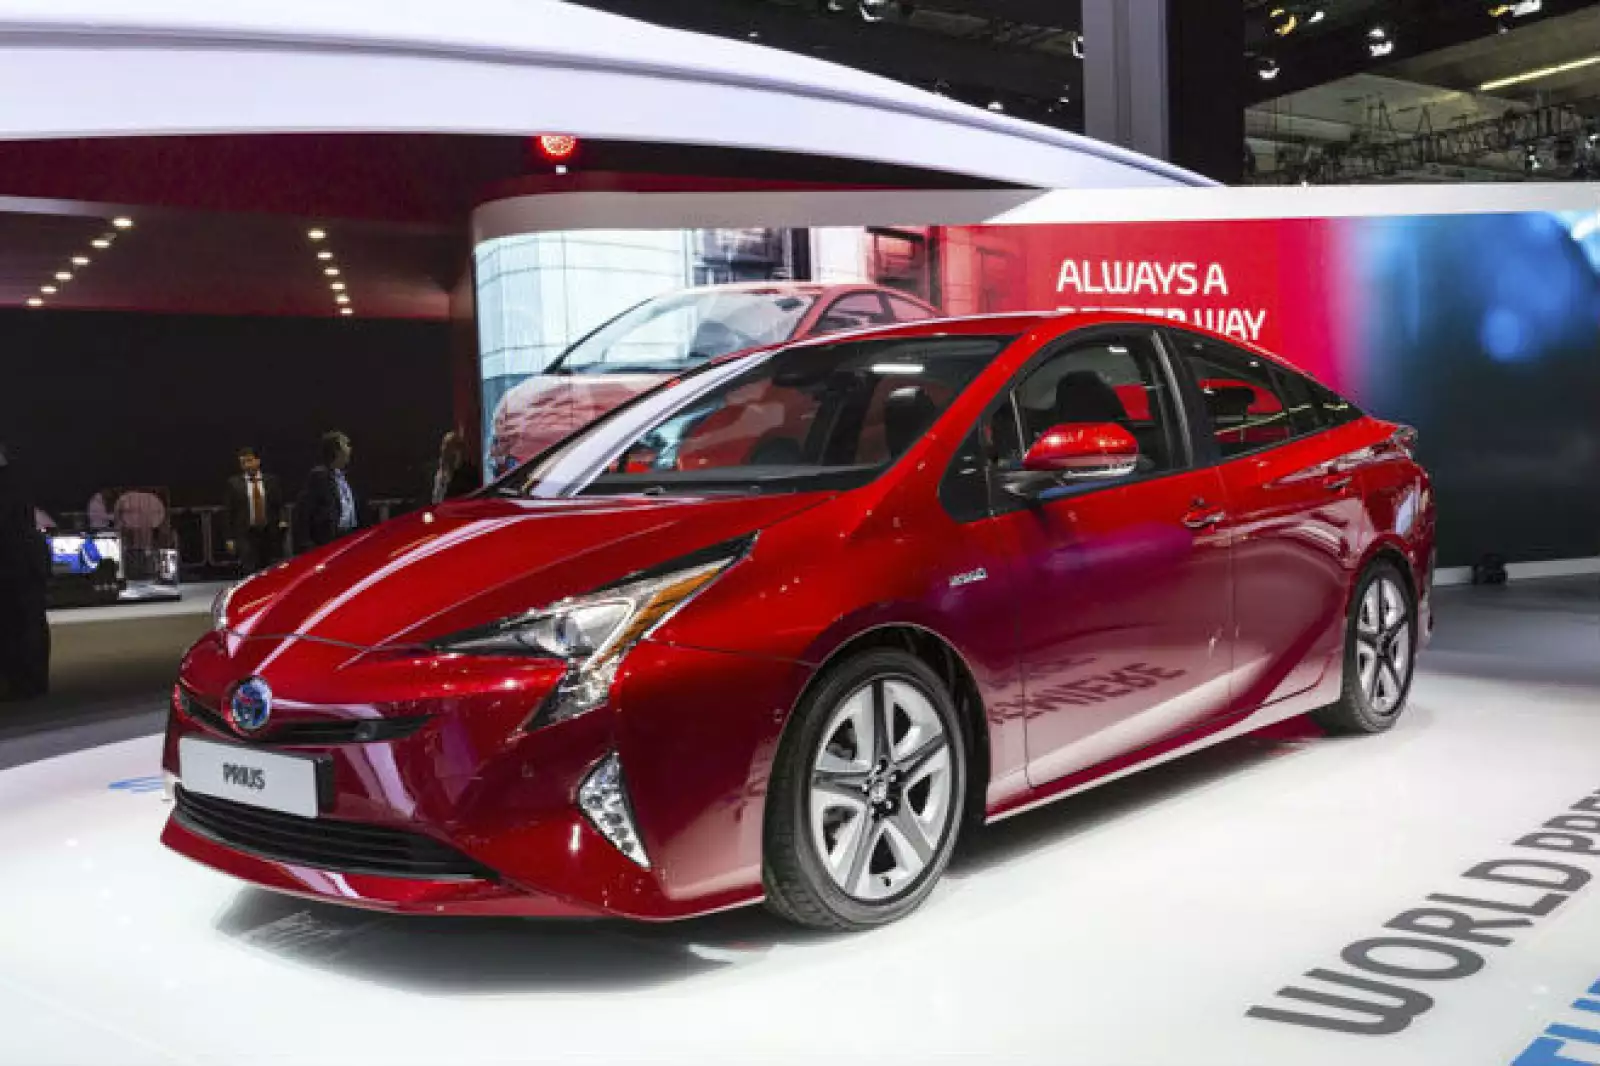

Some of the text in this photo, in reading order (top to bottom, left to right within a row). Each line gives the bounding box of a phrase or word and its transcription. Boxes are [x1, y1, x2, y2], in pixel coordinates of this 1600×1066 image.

[1056, 259, 1228, 295] ALWAYS A
[1192, 307, 1266, 341] WAY
[222, 762, 266, 791] PRIUS
[1244, 858, 1594, 1035] WORLD
[1510, 789, 1600, 856] PR
